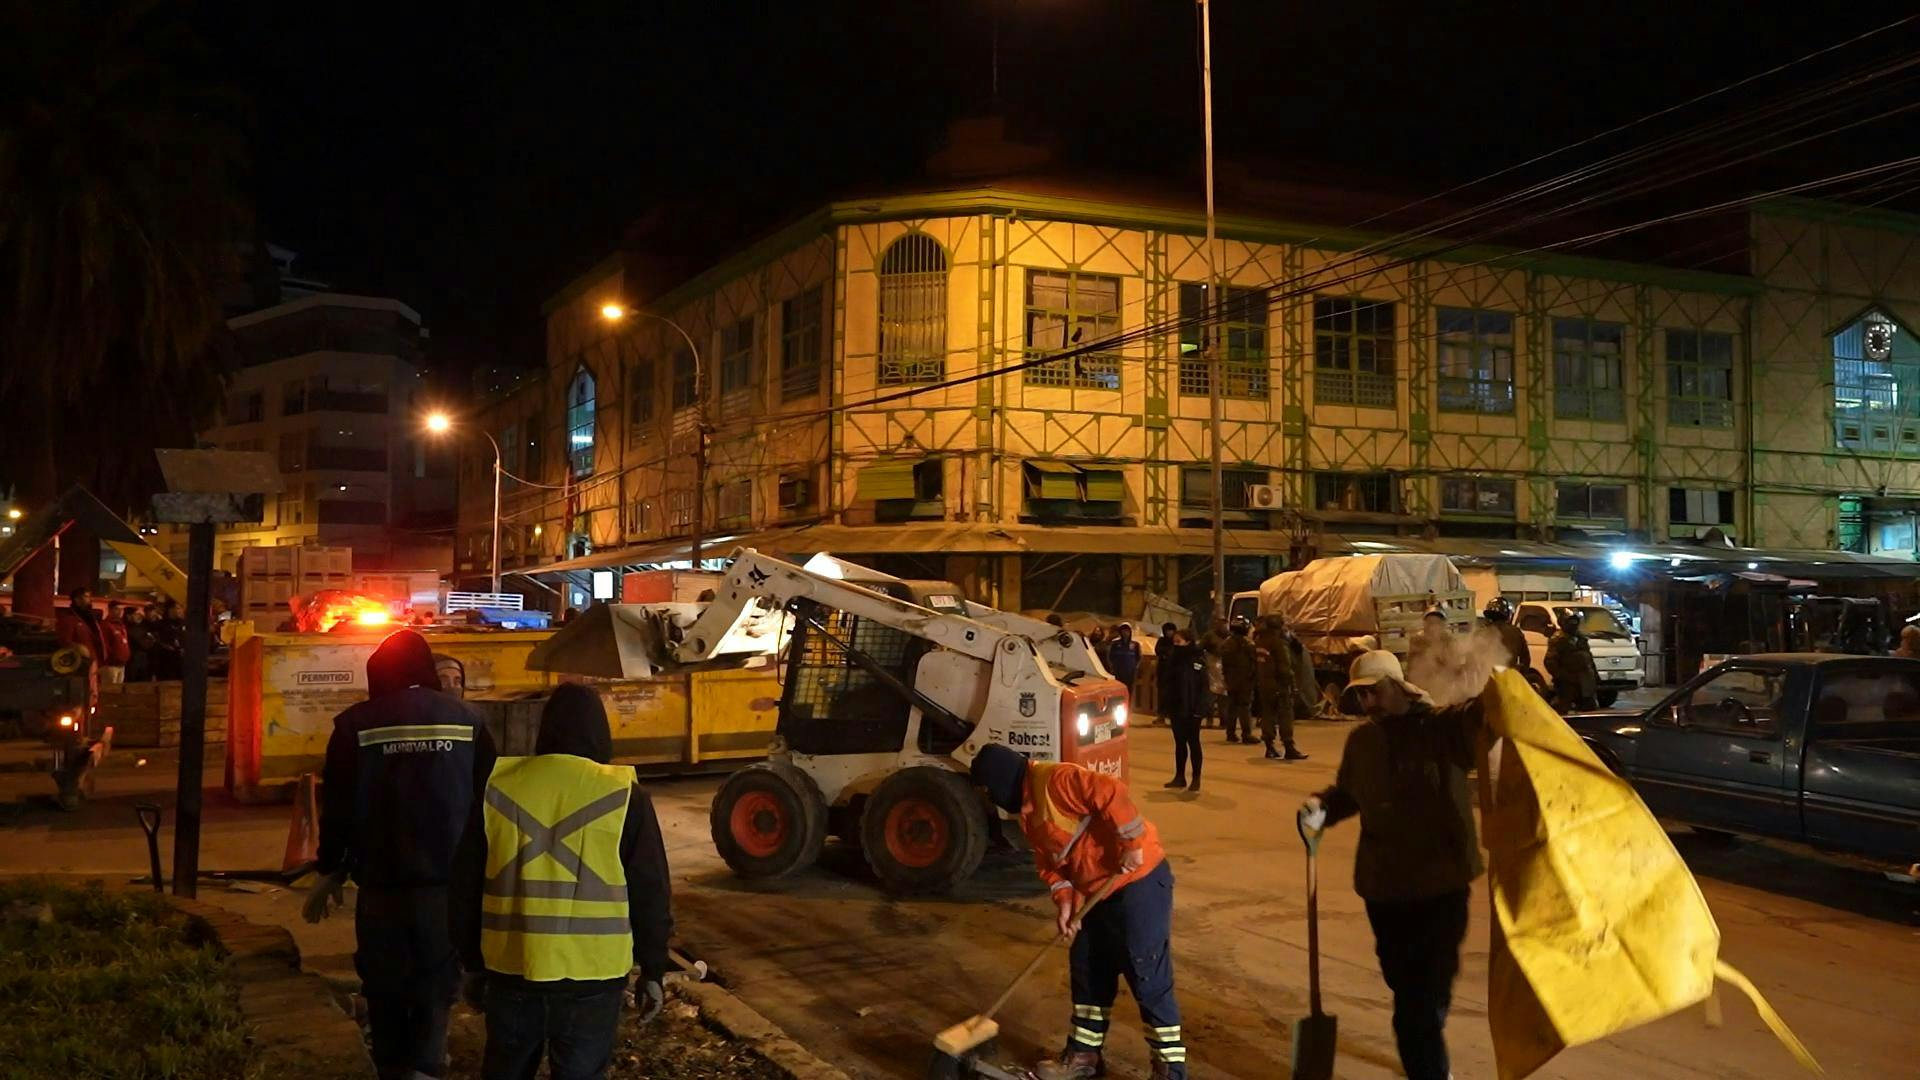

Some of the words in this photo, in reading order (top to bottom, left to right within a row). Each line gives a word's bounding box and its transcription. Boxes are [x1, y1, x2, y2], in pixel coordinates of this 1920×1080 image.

[301, 673, 350, 682] PERMITIDO
[1008, 731, 1051, 747] Bobcat
[383, 740, 453, 755] MUNIVALPO
